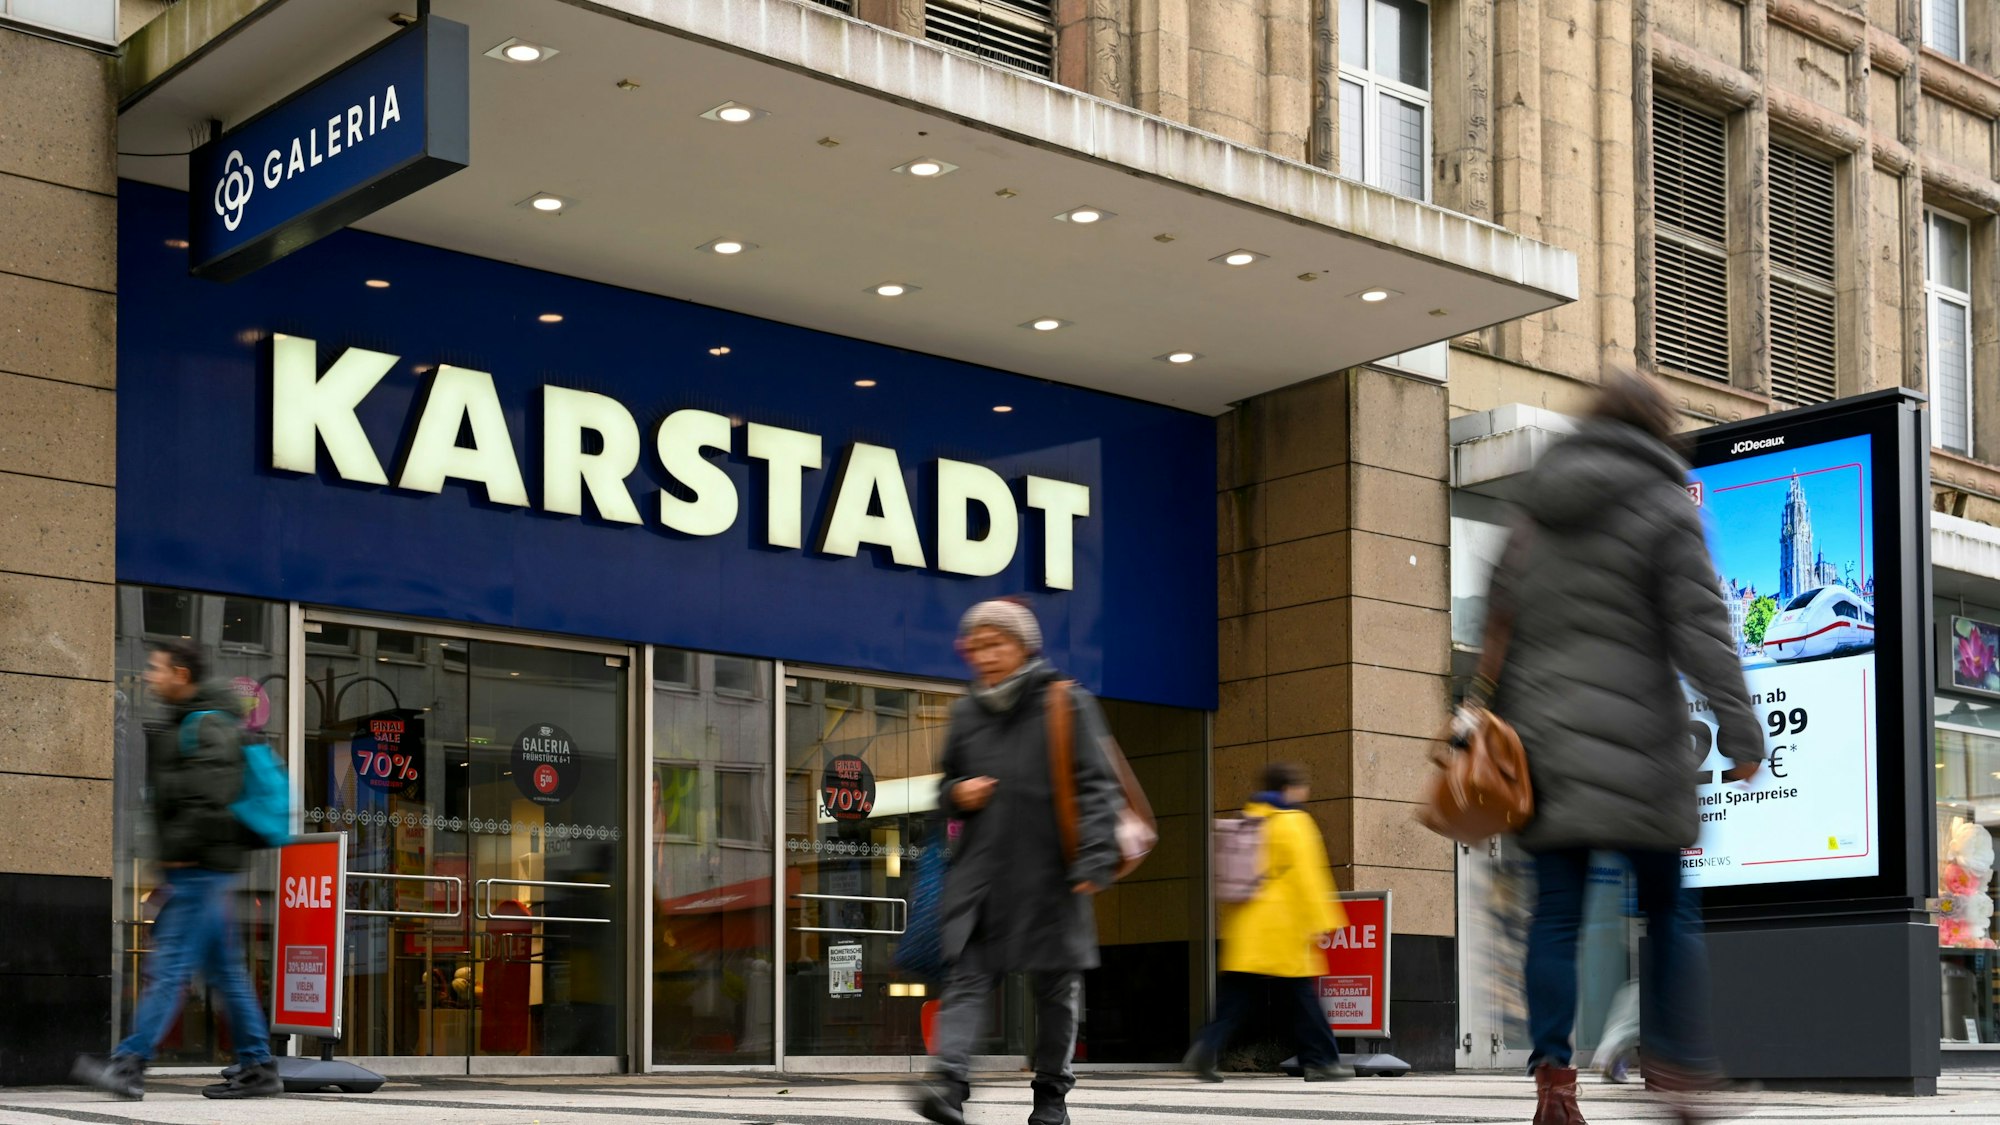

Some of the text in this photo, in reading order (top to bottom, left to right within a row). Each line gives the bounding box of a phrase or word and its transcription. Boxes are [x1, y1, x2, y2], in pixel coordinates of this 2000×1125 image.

[263, 84, 401, 190] GALERIA
[1730, 436, 1785, 455] JCDecaux
[271, 332, 1090, 590] KARSTADT
[1766, 688, 1786, 704] ab
[372, 721, 402, 731] FINAL
[1767, 707, 1808, 737] 99
[374, 731, 401, 743] SALE
[522, 737, 570, 755] GALERIA
[522, 751, 558, 763] FRÜHSTÜCK
[356, 750, 418, 780] 70%
[836, 761, 860, 770] FINAL
[838, 770, 860, 780] SALE
[826, 786, 872, 812] 70%
[1725, 786, 1798, 805] Sparpreise
[284, 876, 332, 909] SALE
[830, 947, 862, 955] BIOMETRISCHE
[300, 961, 324, 973] RABATT
[296, 981, 314, 991] VIELEN
[1323, 987, 1369, 996] 30% RABATT
[290, 992, 319, 1003] BEREICHEN
[1334, 1001, 1357, 1009] VIELEN
[1327, 1010, 1363, 1018] BEREICHEN
